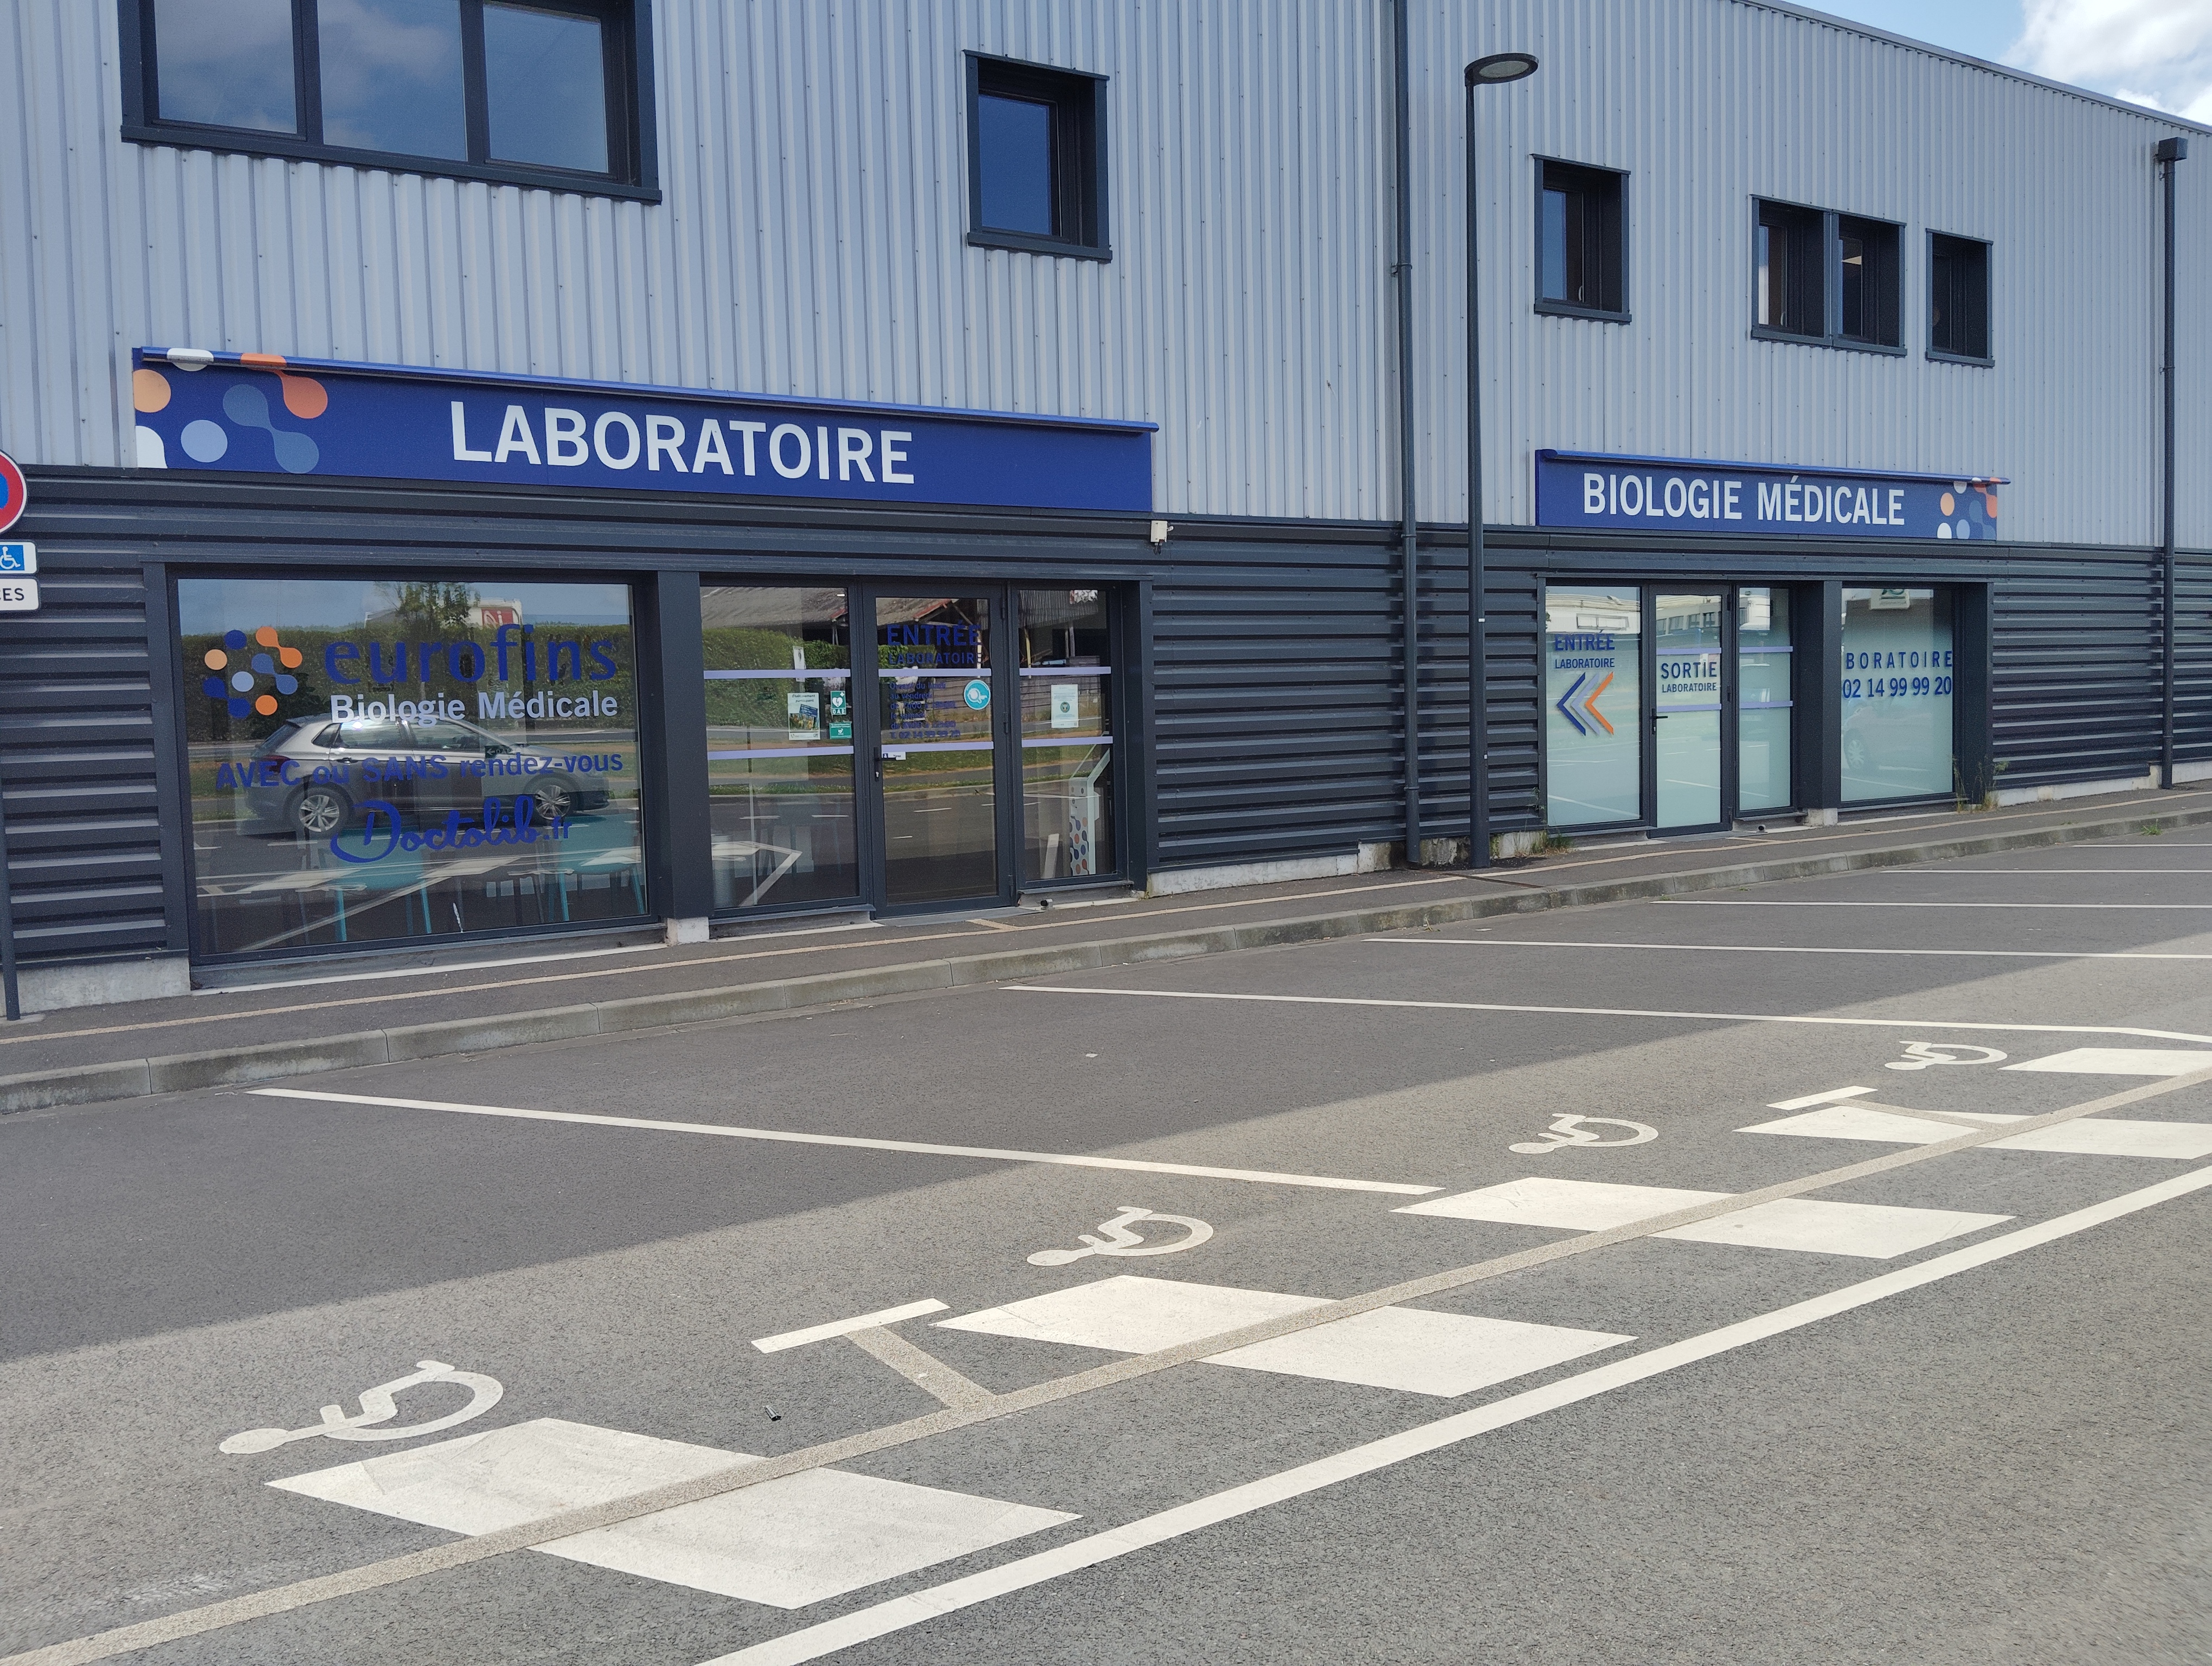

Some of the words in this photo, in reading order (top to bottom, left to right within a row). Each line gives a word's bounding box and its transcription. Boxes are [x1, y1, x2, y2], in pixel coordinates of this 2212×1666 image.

[449, 401, 915, 485] LABORATOIRE
[1583, 472, 1742, 520] BIOLOGIE
[1757, 475, 1905, 526] MÉDICALE
[0, 588, 24, 601] ES
[887, 619, 981, 646] ENTRÉE
[325, 624, 618, 685] eurofins
[1555, 658, 1616, 669] LABORATOIRE
[1846, 651, 1953, 670] BORATOIRE
[1661, 662, 1718, 679] SORTIE
[1662, 682, 1718, 693] LABORATOIRE
[1843, 678, 1861, 699] 02
[1868, 678, 1885, 697] 14
[1889, 677, 1908, 697] 99
[1912, 677, 1930, 696] 99
[1934, 676, 1952, 695] 20
[330, 692, 466, 727] Biologie
[478, 690, 619, 720] Médicale
[216, 760, 302, 789] AVEC
[313, 765, 350, 785] ou
[362, 754, 449, 782] SANS
[460, 752, 623, 778] rendez-vous
